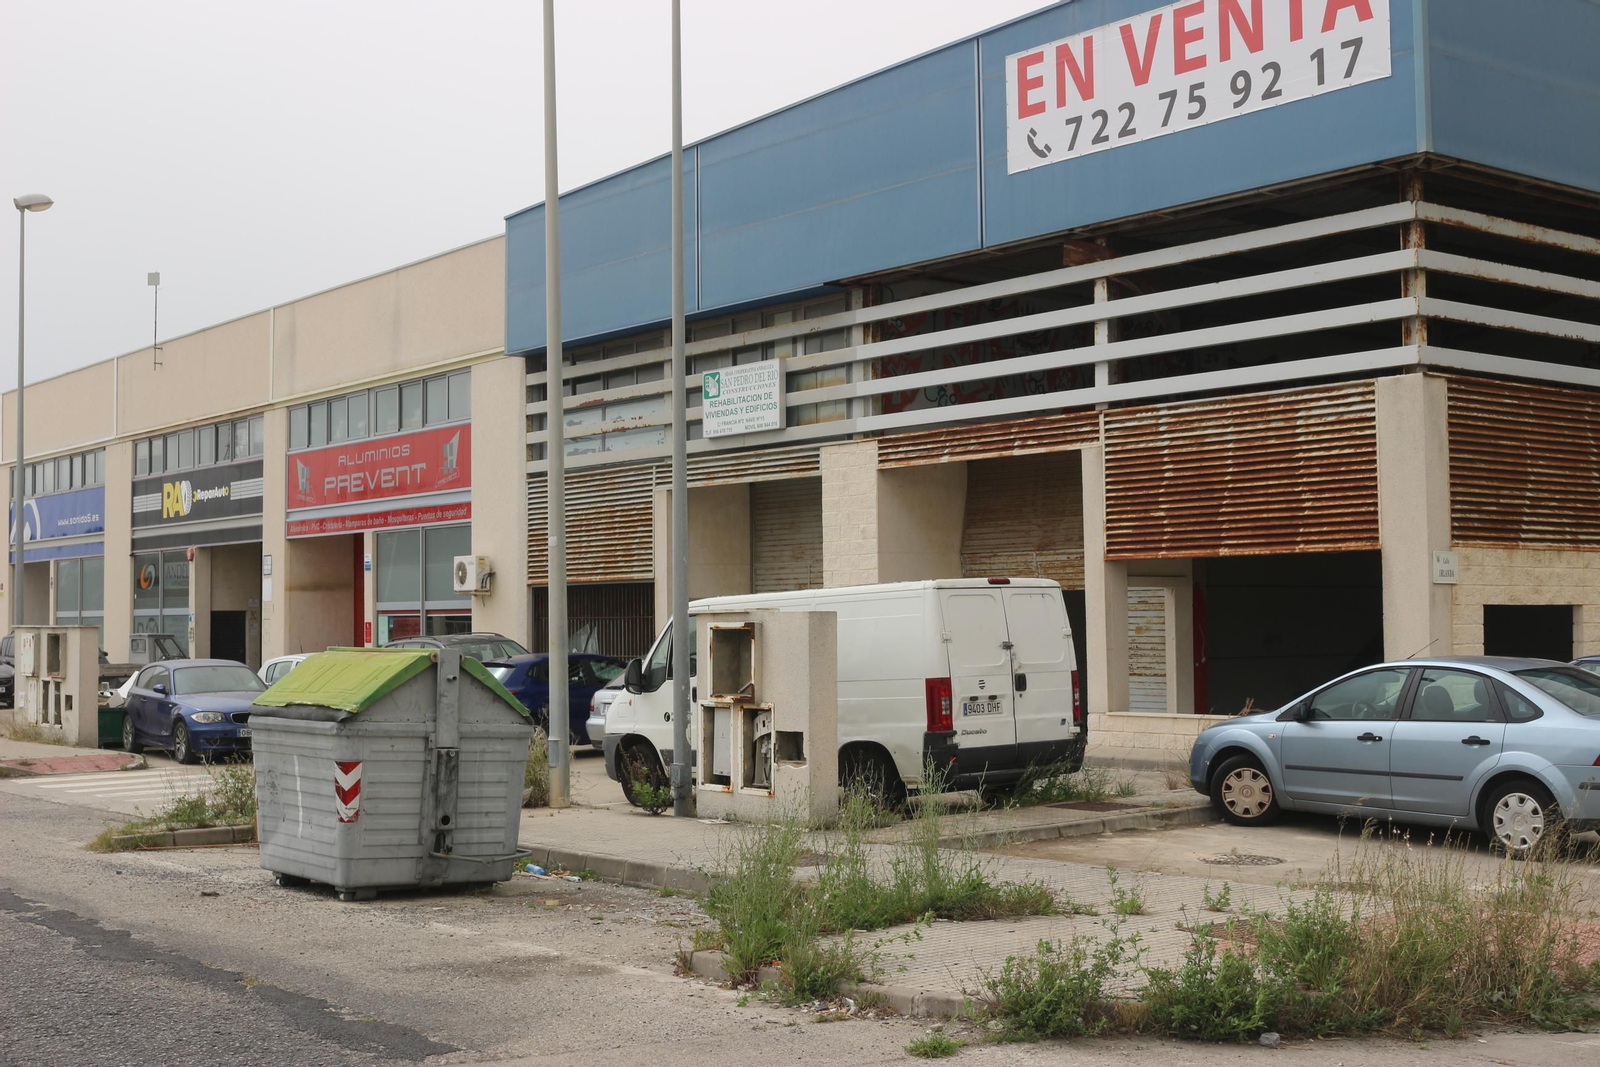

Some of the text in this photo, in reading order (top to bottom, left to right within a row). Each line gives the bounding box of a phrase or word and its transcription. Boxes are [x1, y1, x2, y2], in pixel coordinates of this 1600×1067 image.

[1016, 35, 1095, 120] EN
[1065, 36, 1364, 152] 722 75 92 17
[720, 377, 732, 389] SAN
[734, 374, 754, 386] PEDRO
[754, 372, 766, 383] DEL
[723, 382, 776, 395] CONSTRUCCIONES
[710, 392, 772, 408] REHABILITACION DE
[705, 408, 738, 419] VIVIENDAS
[746, 402, 778, 414] EDIFICIOS
[338, 444, 410, 466] ALUMINIOS
[324, 462, 426, 496] PREVENT
[387, 514, 414, 524] Mosquiteras
[443, 506, 467, 519] seguridad
[968, 704, 985, 713] 9403
